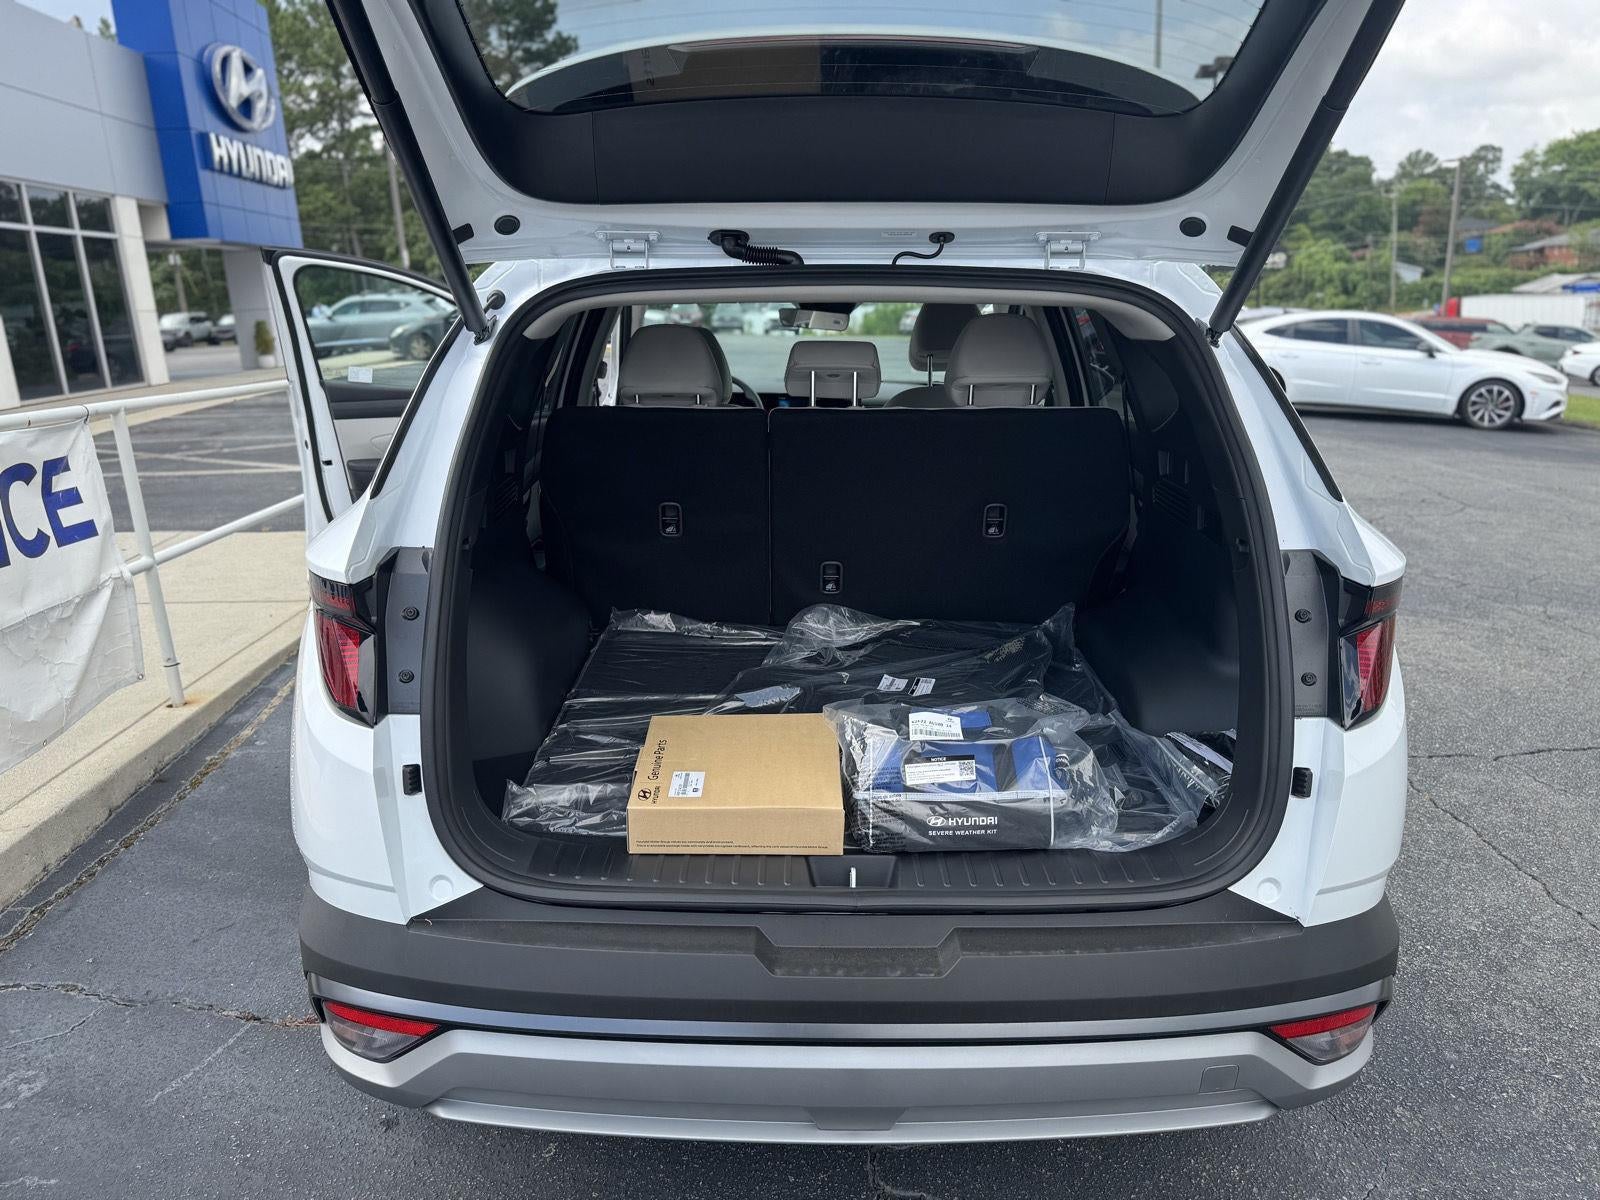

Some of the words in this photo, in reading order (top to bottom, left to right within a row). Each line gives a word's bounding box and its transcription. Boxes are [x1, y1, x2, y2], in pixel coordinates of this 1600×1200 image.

[210, 132, 294, 188] HYUNDAI
[0, 455, 99, 567] CE
[654, 739, 667, 755] Parts
[648, 756, 663, 781] Genuine
[652, 785, 661, 804] HYUNDAI
[948, 816, 998, 826] HYUNDAI
